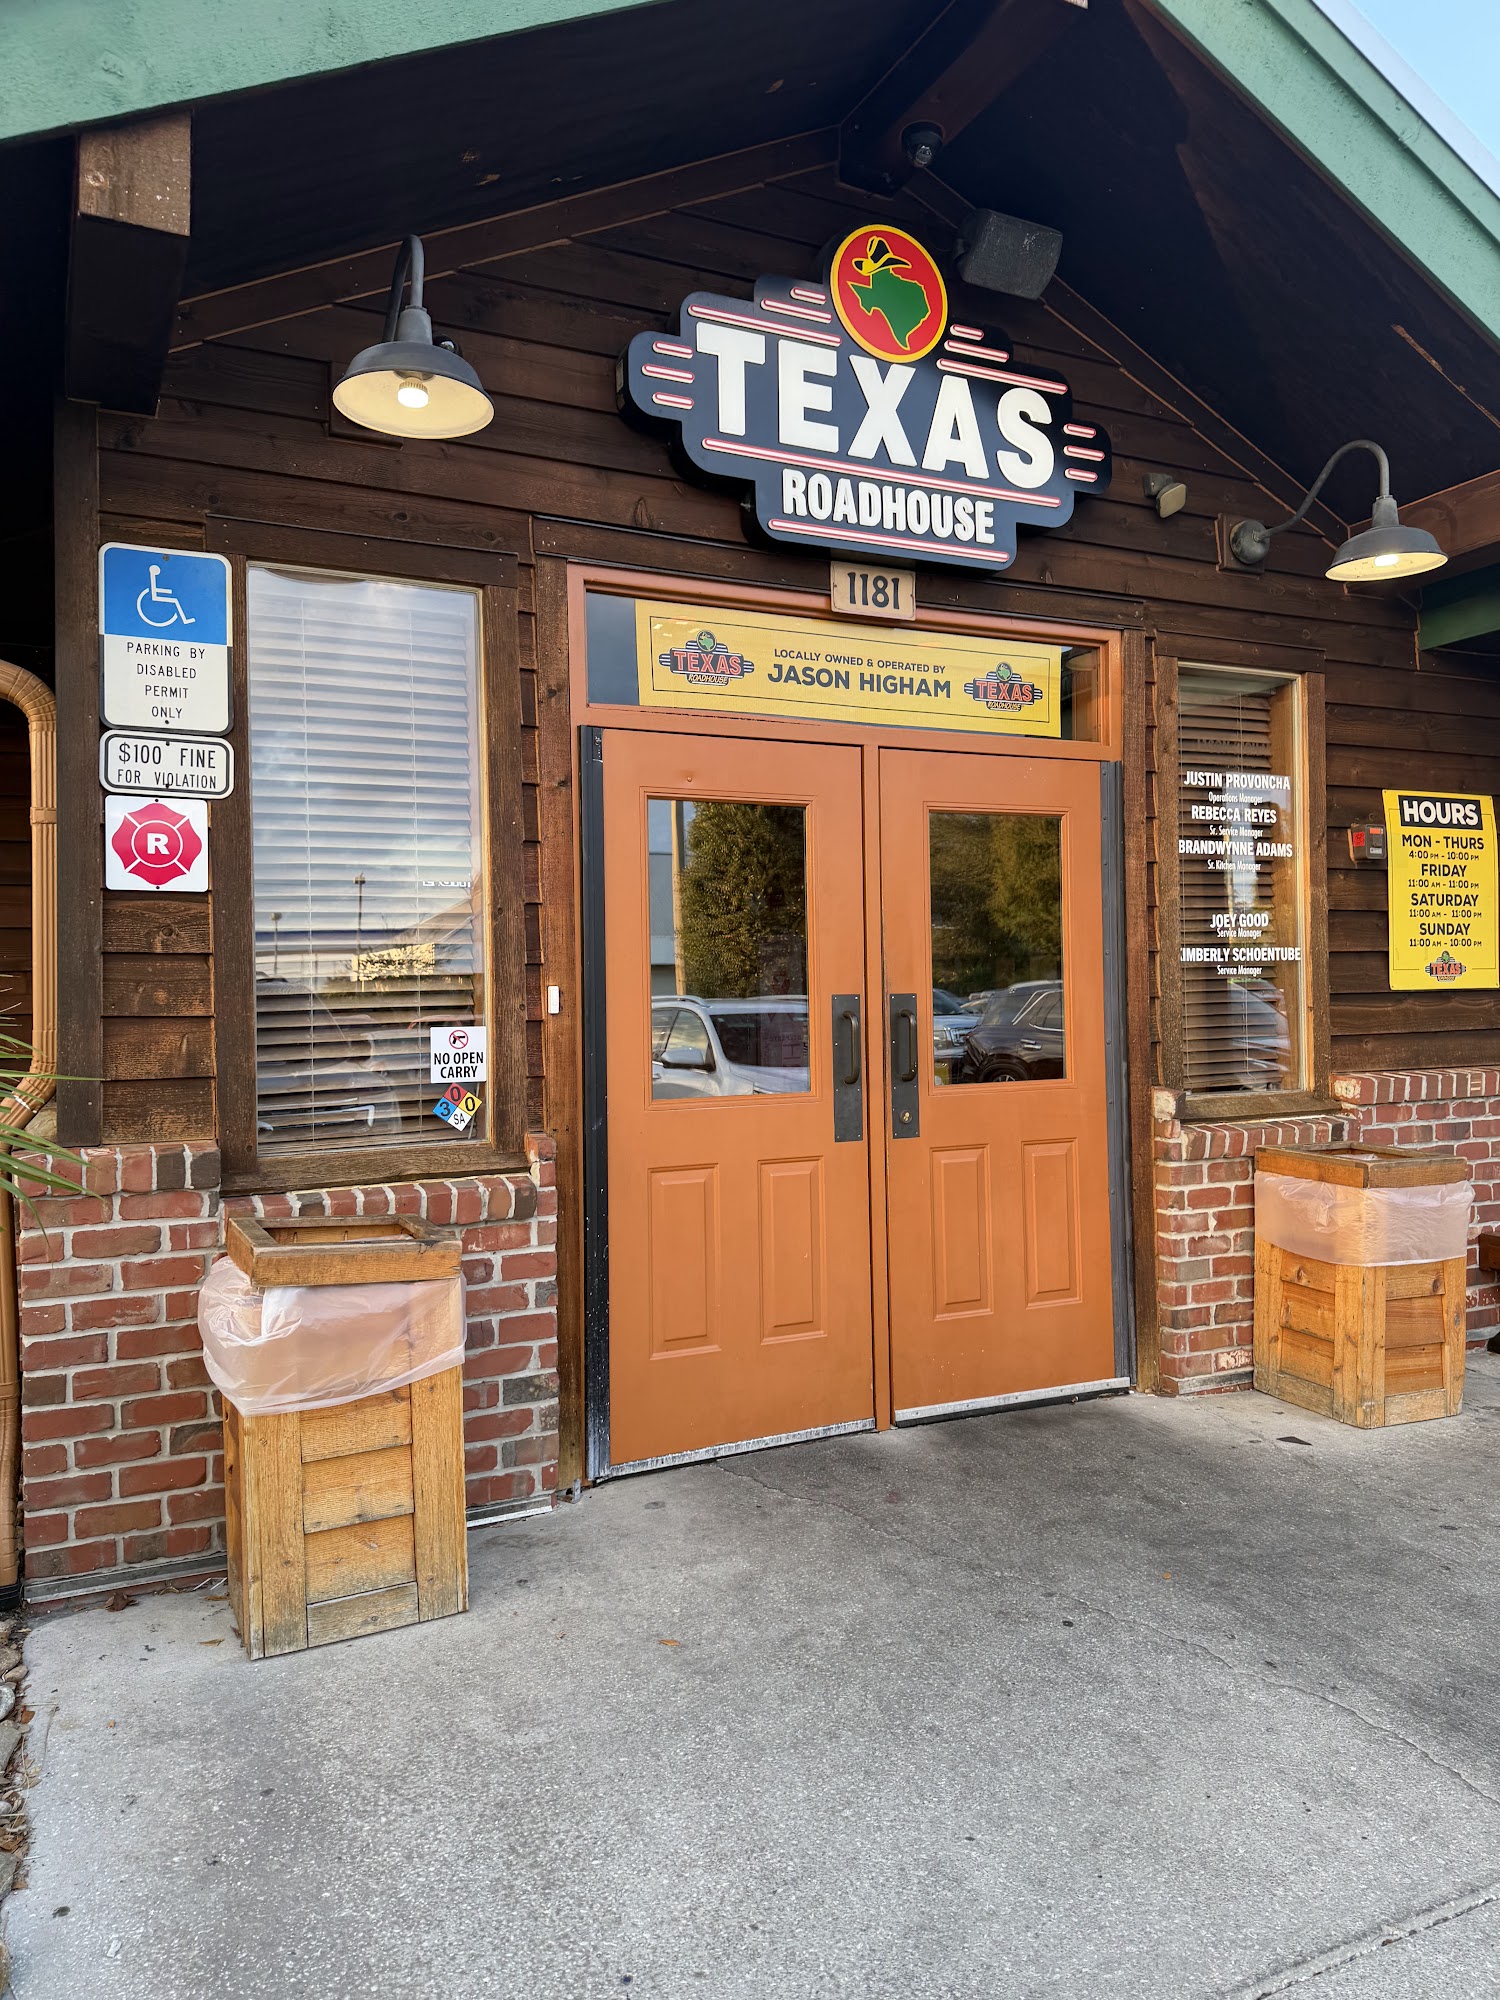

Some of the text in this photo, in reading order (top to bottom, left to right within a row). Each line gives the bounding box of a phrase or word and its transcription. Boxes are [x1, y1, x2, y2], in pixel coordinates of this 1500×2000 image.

[696, 321, 1055, 489] TEXAS
[782, 468, 995, 544] ROADHOUSE
[846, 571, 900, 610] 1181
[127, 641, 206, 659] PARKING BY
[673, 650, 742, 675] TEXAS
[774, 648, 946, 674] LOCALLY OWNED & OPERATED BY
[136, 663, 197, 679] DISABLED
[688, 674, 728, 684] ROADHOUSE
[767, 663, 951, 699] JASON HIGHAM
[145, 684, 189, 699] PERMIT
[976, 681, 1033, 703] TEXAS
[151, 705, 183, 719] ONLY
[118, 742, 216, 769] $100 FINE
[117, 768, 217, 789] FOR VIOLATION
[1183, 770, 1291, 790] JUSTIN PROVONCHA
[1208, 791, 1263, 805] Operations Manager
[1191, 804, 1277, 824] REBECCA REYES
[1402, 800, 1479, 826] HOURS
[1209, 824, 1263, 839] Sr. Service Manager
[146, 832, 170, 855] R
[1178, 839, 1293, 858] BRANDWYNNE ADAMS
[1401, 834, 1432, 848] MON
[1443, 836, 1485, 850] THURS
[1408, 850, 1429, 859] 4:00
[1447, 851, 1469, 860] 10:00
[1215, 859, 1236, 870] Kitchen
[1237, 860, 1261, 873] Manager
[1421, 863, 1467, 877] FRIDAY
[1408, 879, 1429, 888] 11:00
[1448, 880, 1469, 889] 11:00
[1411, 893, 1479, 907] SATURDAY
[1209, 913, 1269, 929] JOEY GOOD
[1409, 909, 1430, 918] 11:00
[1451, 909, 1472, 918] 11:00
[1216, 927, 1262, 940] Service Manager
[1419, 922, 1471, 936] SUNDAY
[1409, 938, 1431, 947] 11:00
[1449, 938, 1472, 947] 10:00
[1232, 947, 1301, 962] SCHOENTUBE
[1216, 964, 1262, 977] Service Manager
[1431, 962, 1461, 975] TEXAS
[433, 1051, 484, 1065] NO OPEN
[440, 1065, 478, 1079] CARRY
[449, 1086, 462, 1102] 0
[439, 1101, 451, 1117] 3
[464, 1096, 476, 1112] 0
[453, 1112, 466, 1125] SA
